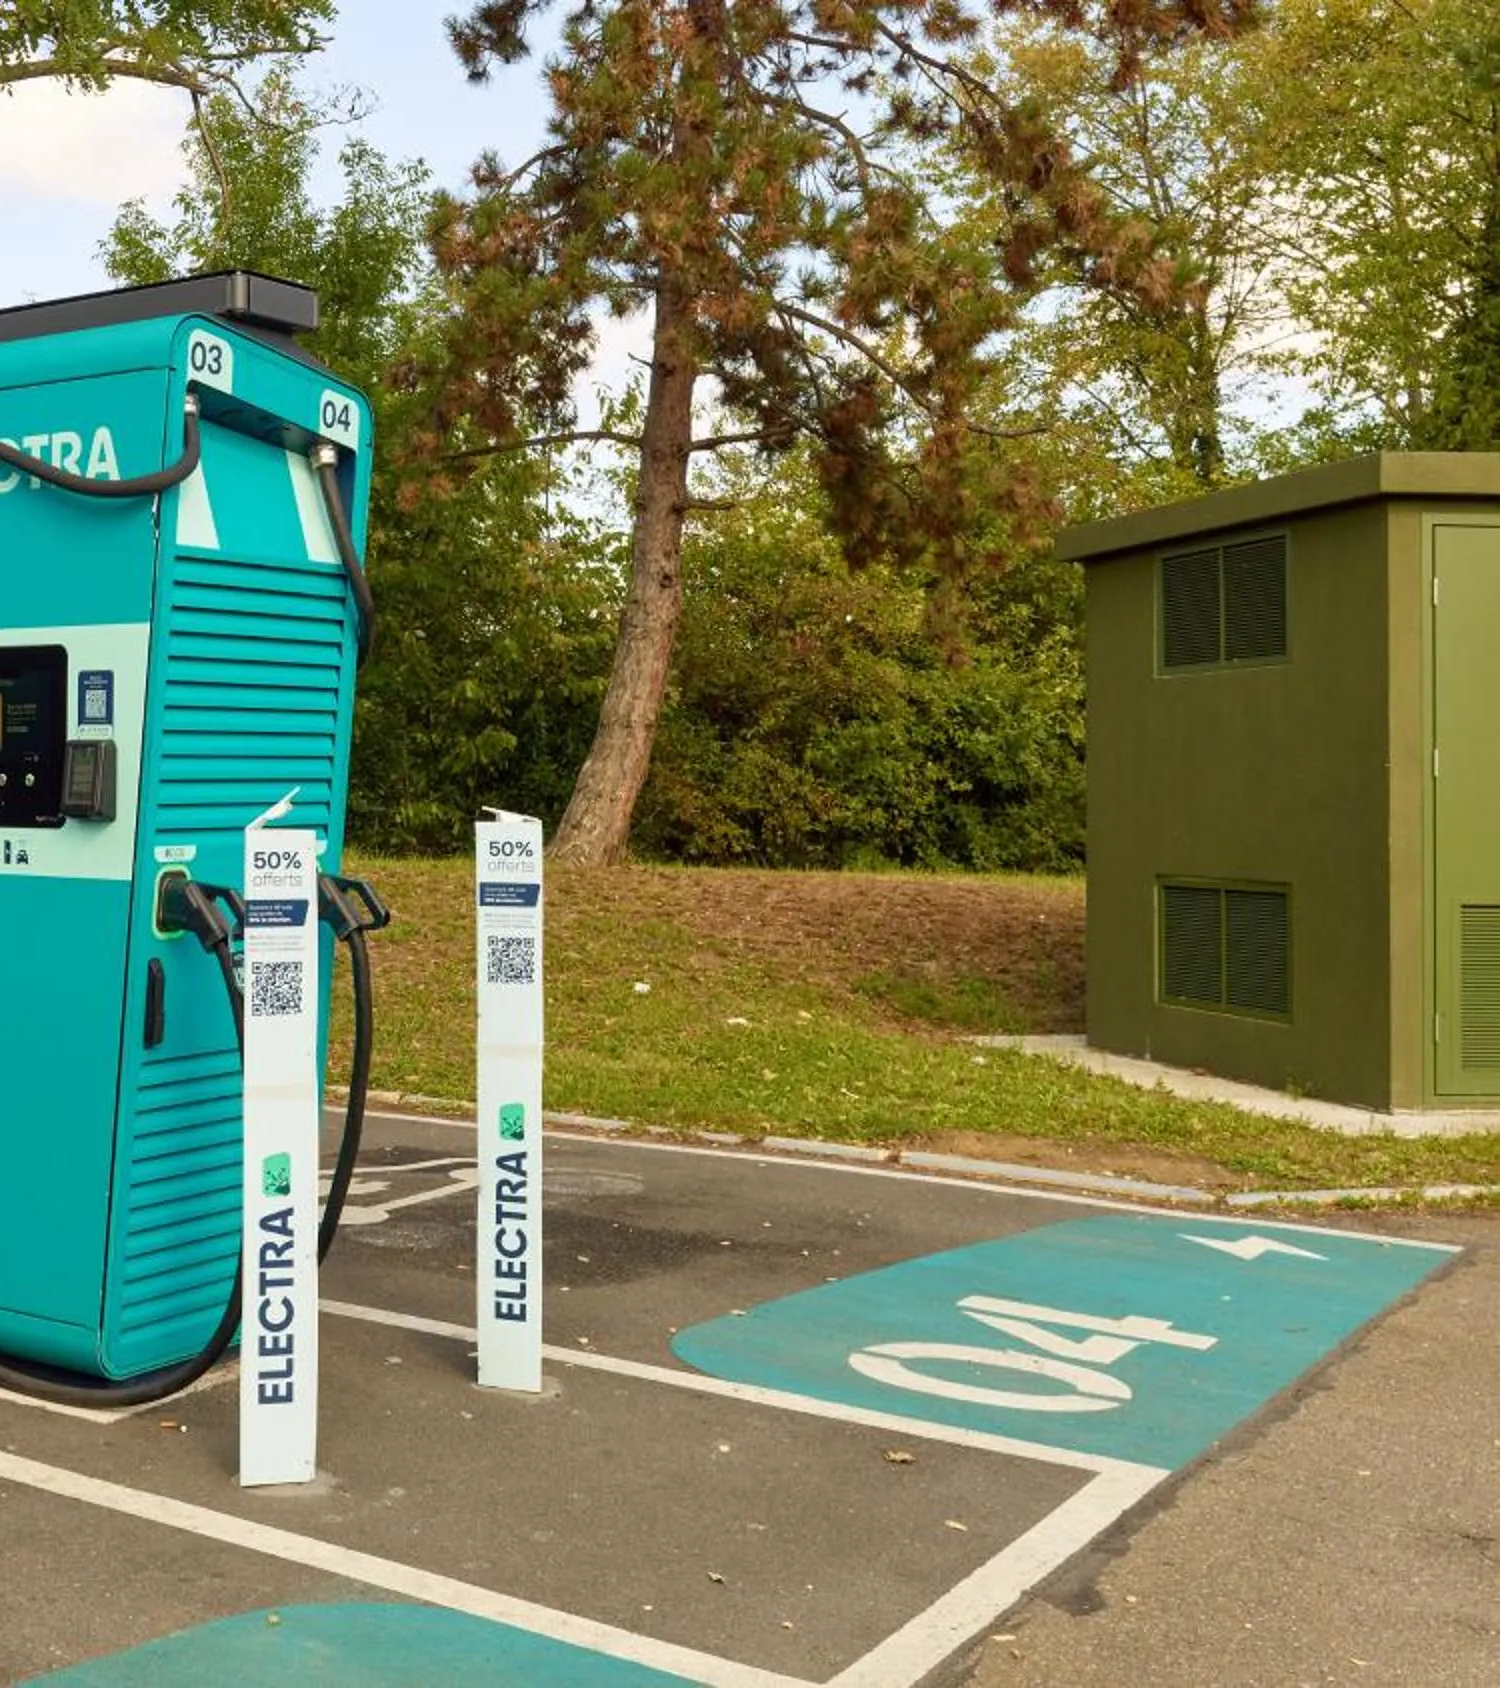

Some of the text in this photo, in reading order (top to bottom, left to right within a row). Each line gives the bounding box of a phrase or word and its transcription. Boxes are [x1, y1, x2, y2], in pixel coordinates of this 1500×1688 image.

[191, 341, 222, 375] 03
[322, 400, 351, 432] 04
[253, 851, 302, 869] 50%
[488, 841, 534, 857] 50%
[252, 871, 303, 888] offerts
[495, 1151, 528, 1322] ELECTRA
[258, 1206, 294, 1405] ELECTRA
[848, 1295, 1219, 1412] 04
